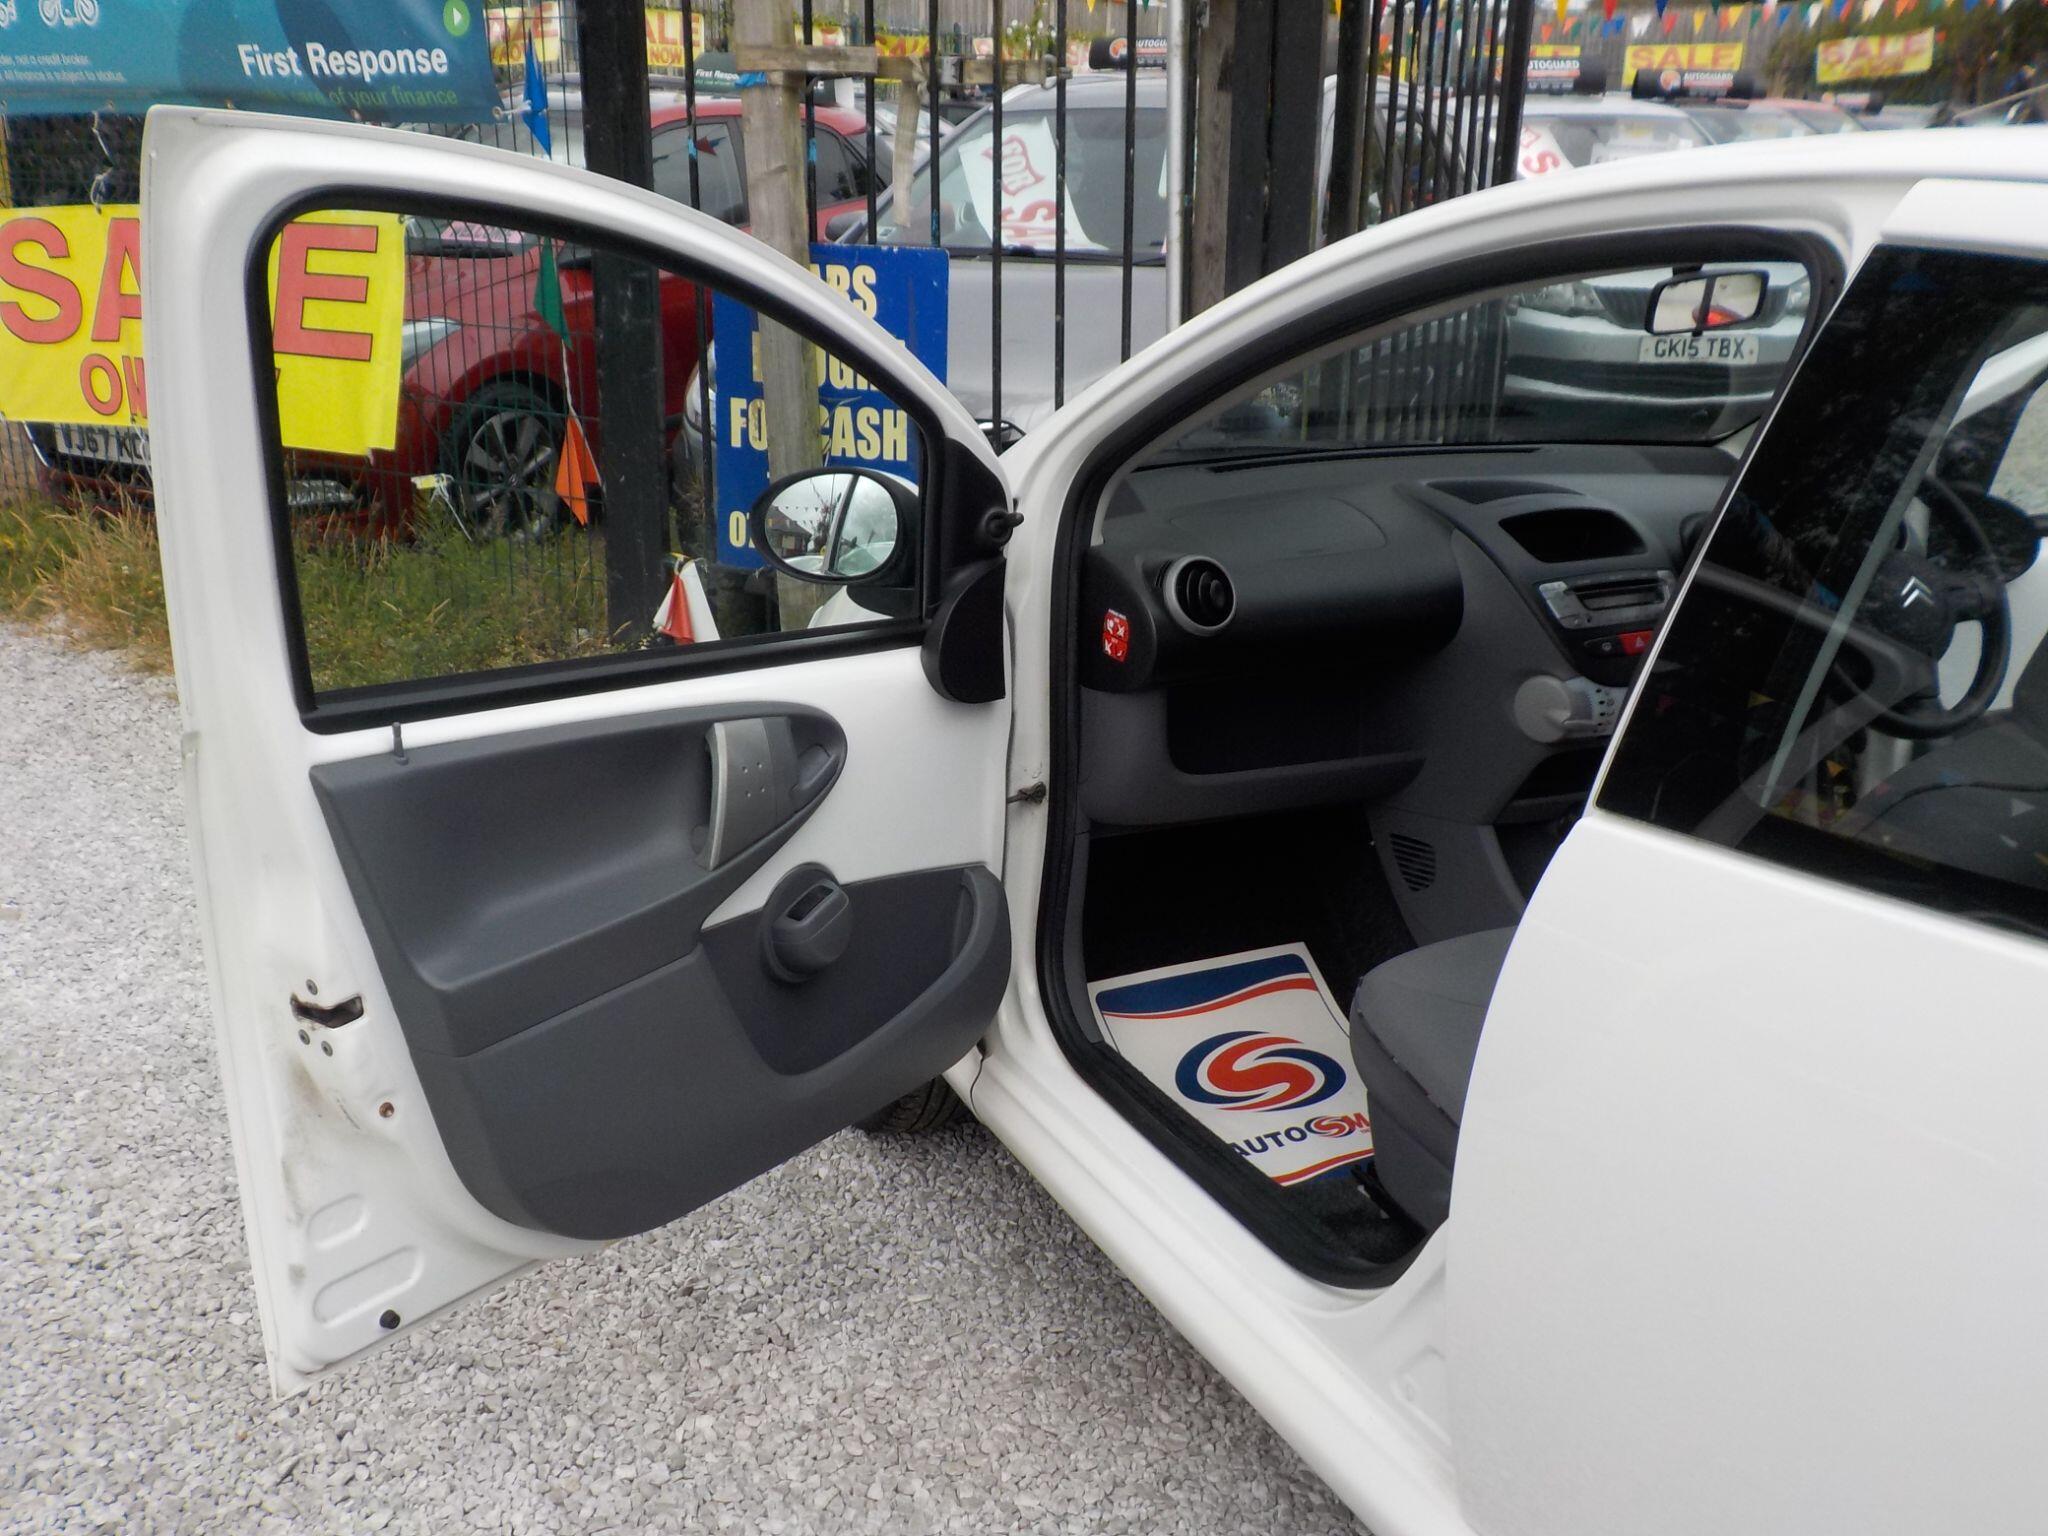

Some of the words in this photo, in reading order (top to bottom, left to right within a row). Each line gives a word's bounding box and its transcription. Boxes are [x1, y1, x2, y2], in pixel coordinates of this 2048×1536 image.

[238, 42, 302, 77] First
[306, 42, 448, 83] Response
[1528, 59, 1580, 70] UTOGUARD
[1631, 44, 1737, 71] SALE
[714, 71, 740, 81] Respo
[350, 88, 388, 108] your
[391, 84, 458, 105] finance
[0, 217, 379, 362] SAE
[1654, 338, 1699, 359] GK15
[1707, 338, 1744, 360] TBX
[730, 398, 768, 450] FO
